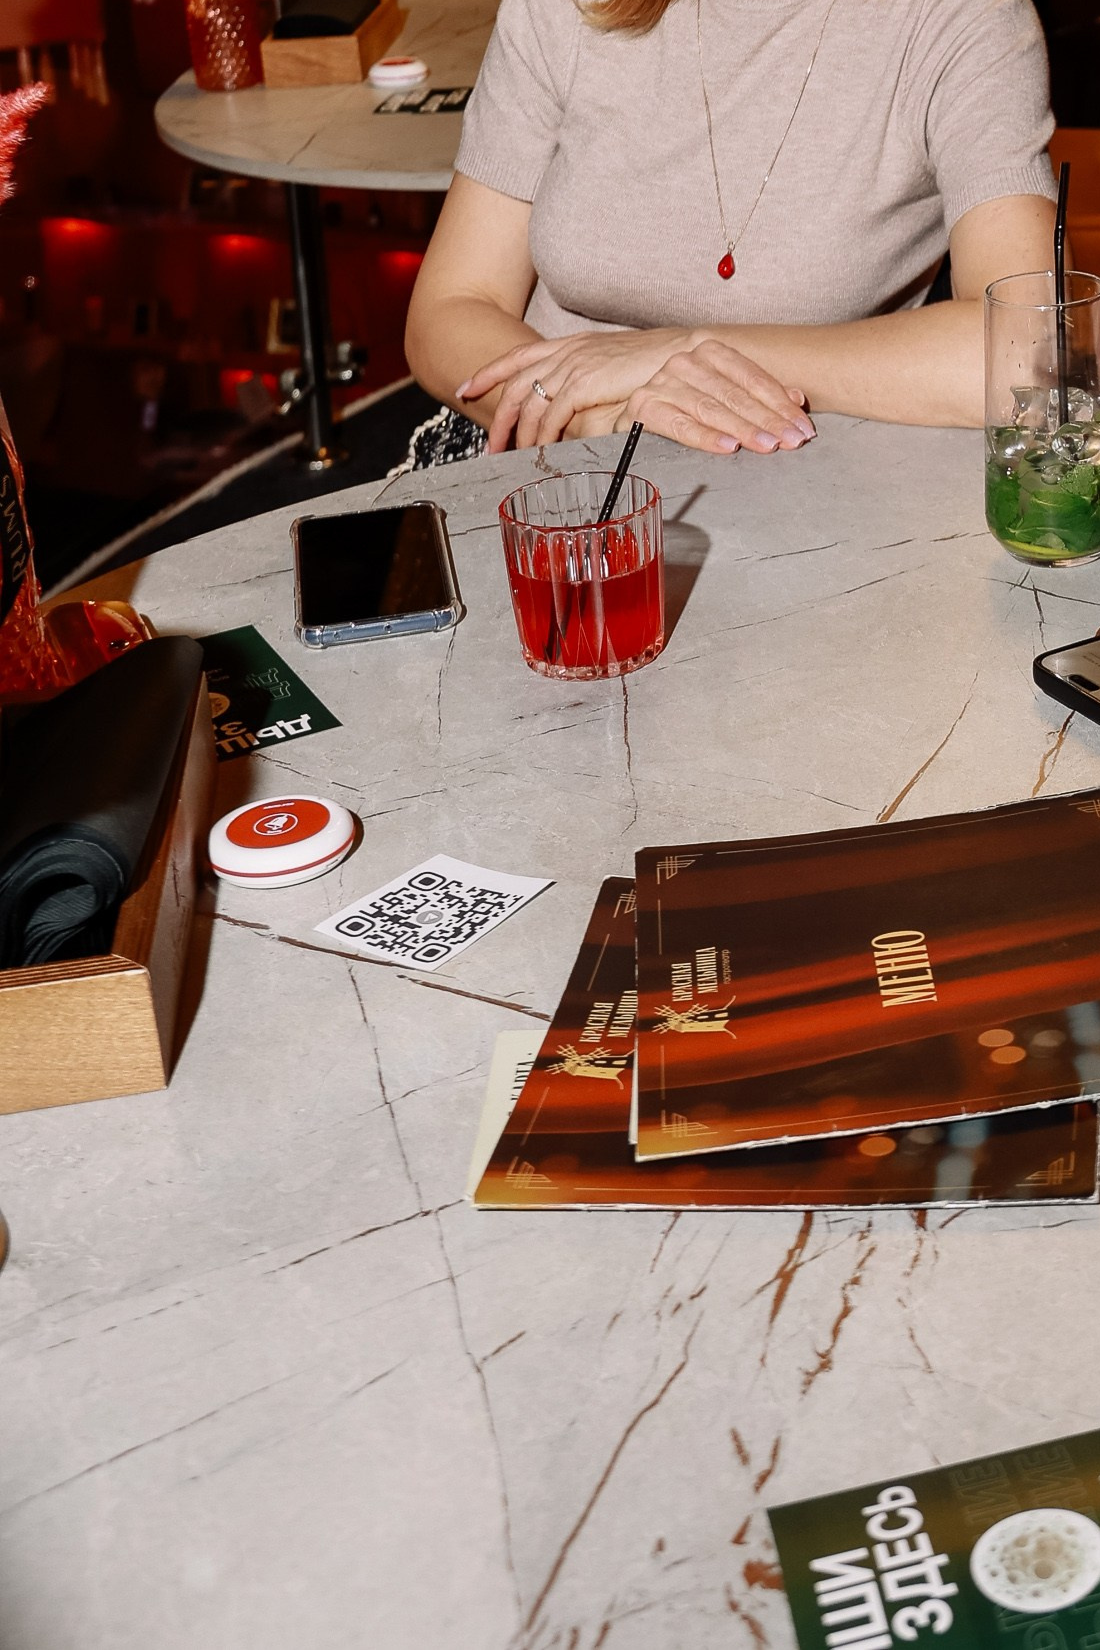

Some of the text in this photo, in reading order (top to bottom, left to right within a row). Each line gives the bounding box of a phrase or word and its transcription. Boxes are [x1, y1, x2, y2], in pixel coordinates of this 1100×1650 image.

[216, 713, 312, 753] ДЫШ
[671, 962, 693, 1002] КРАСНАЯ
[696, 947, 718, 994] МЕЛЬНИЦА
[872, 931, 937, 1007] МЕНЮ
[579, 1002, 615, 1043] КРАСНАЯ
[607, 989, 638, 1038] МЕЛЬНИЦА
[861, 1485, 959, 1641] ЗДЕСЬ
[808, 1547, 894, 1650] ШИ
